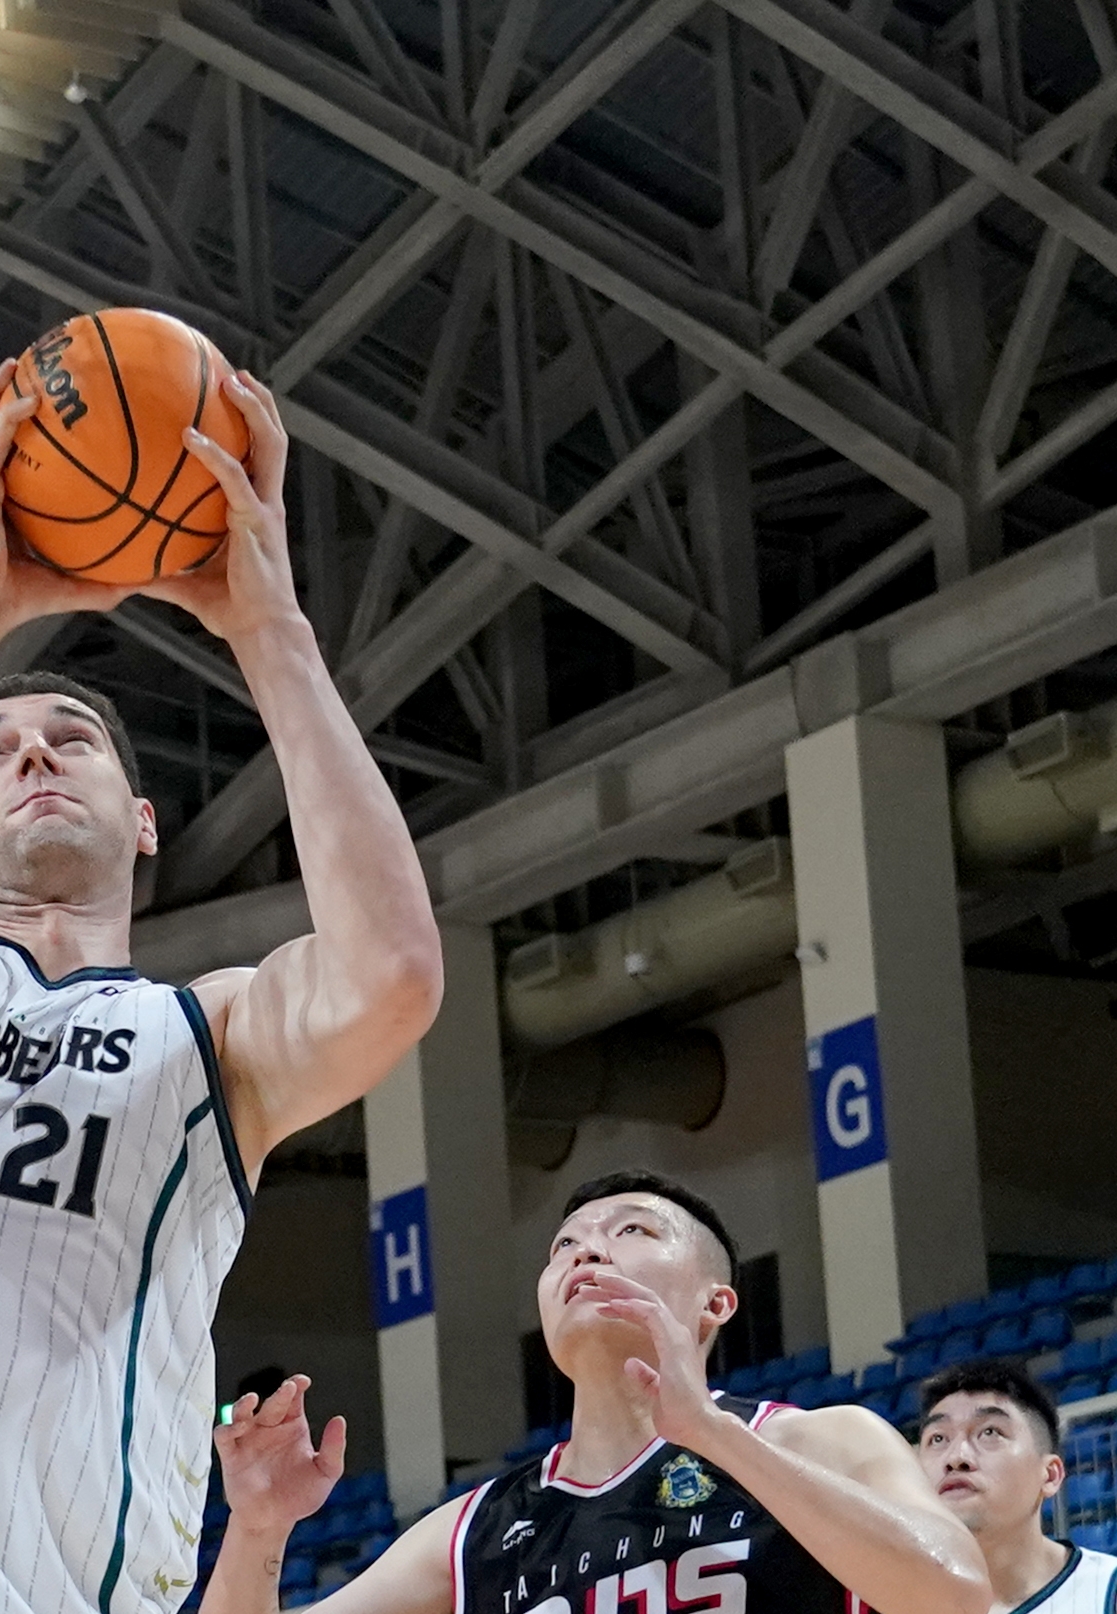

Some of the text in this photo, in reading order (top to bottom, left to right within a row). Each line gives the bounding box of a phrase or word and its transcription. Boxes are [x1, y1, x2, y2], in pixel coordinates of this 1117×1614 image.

[826, 1064, 872, 1149] G
[385, 1223, 423, 1304] H
[503, 1510, 744, 1614] TAICHUNG
